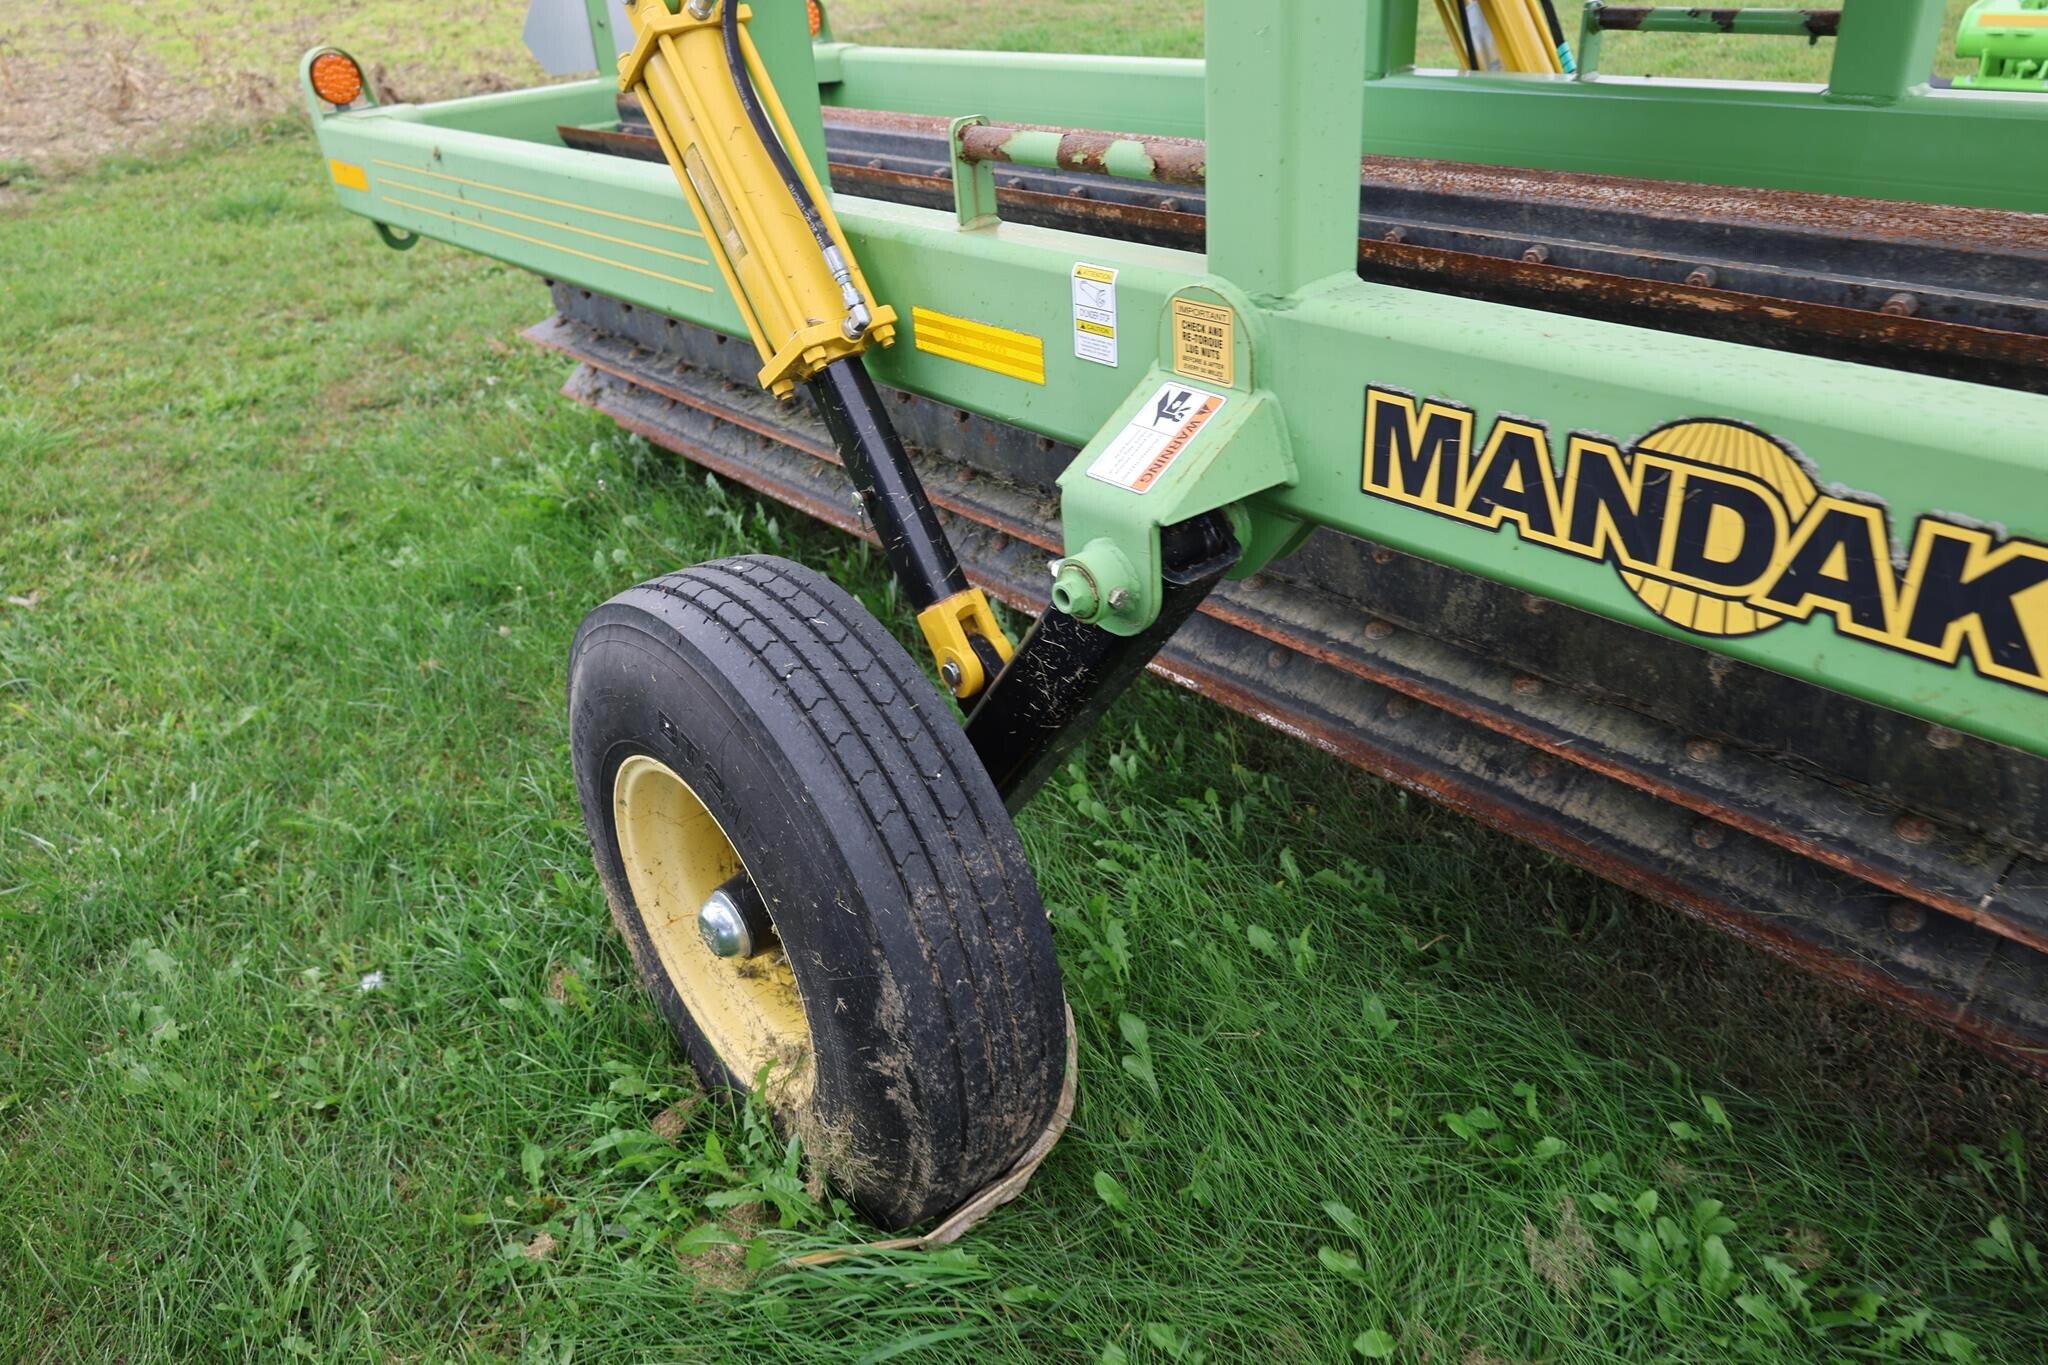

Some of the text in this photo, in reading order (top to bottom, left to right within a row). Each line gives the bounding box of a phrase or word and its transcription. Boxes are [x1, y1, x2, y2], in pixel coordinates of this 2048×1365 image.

[1177, 304, 1228, 321] IMPORTANT
[1085, 323, 1111, 335] CAUTION
[1182, 319, 1224, 337] CHECK AND
[1182, 330, 1223, 350] RE-TORQUE
[1184, 343, 1221, 361] LUG NUTS
[1139, 420, 1201, 483] WARNING
[1361, 383, 2048, 690] MANDAK
